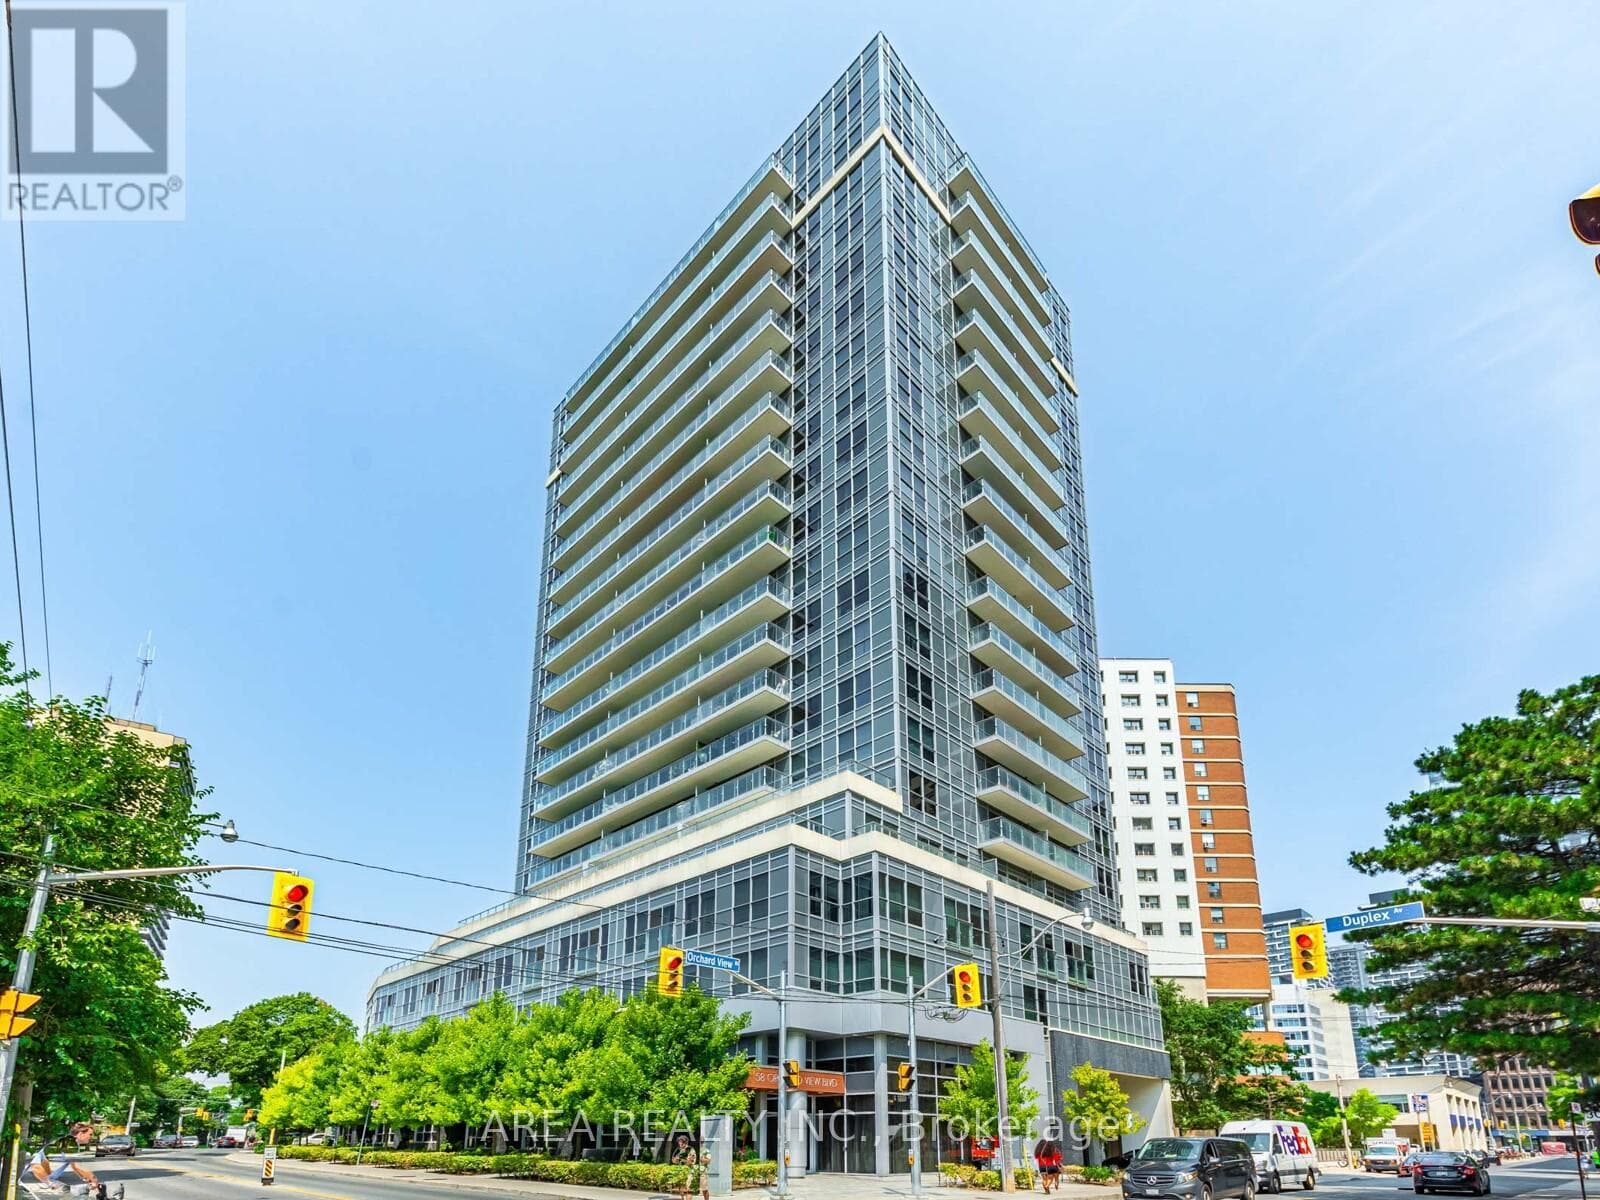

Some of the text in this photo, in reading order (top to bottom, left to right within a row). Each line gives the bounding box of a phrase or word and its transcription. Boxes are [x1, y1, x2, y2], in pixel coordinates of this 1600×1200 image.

[1342, 911, 1391, 927] Duplex
[687, 952, 716, 965] Orchard
[717, 958, 733, 969] View
[755, 1073, 765, 1082] 58
[804, 1076, 820, 1086] VIEW
[821, 1078, 838, 1087] BLVD
[1276, 1125, 1312, 1156] FedEx
